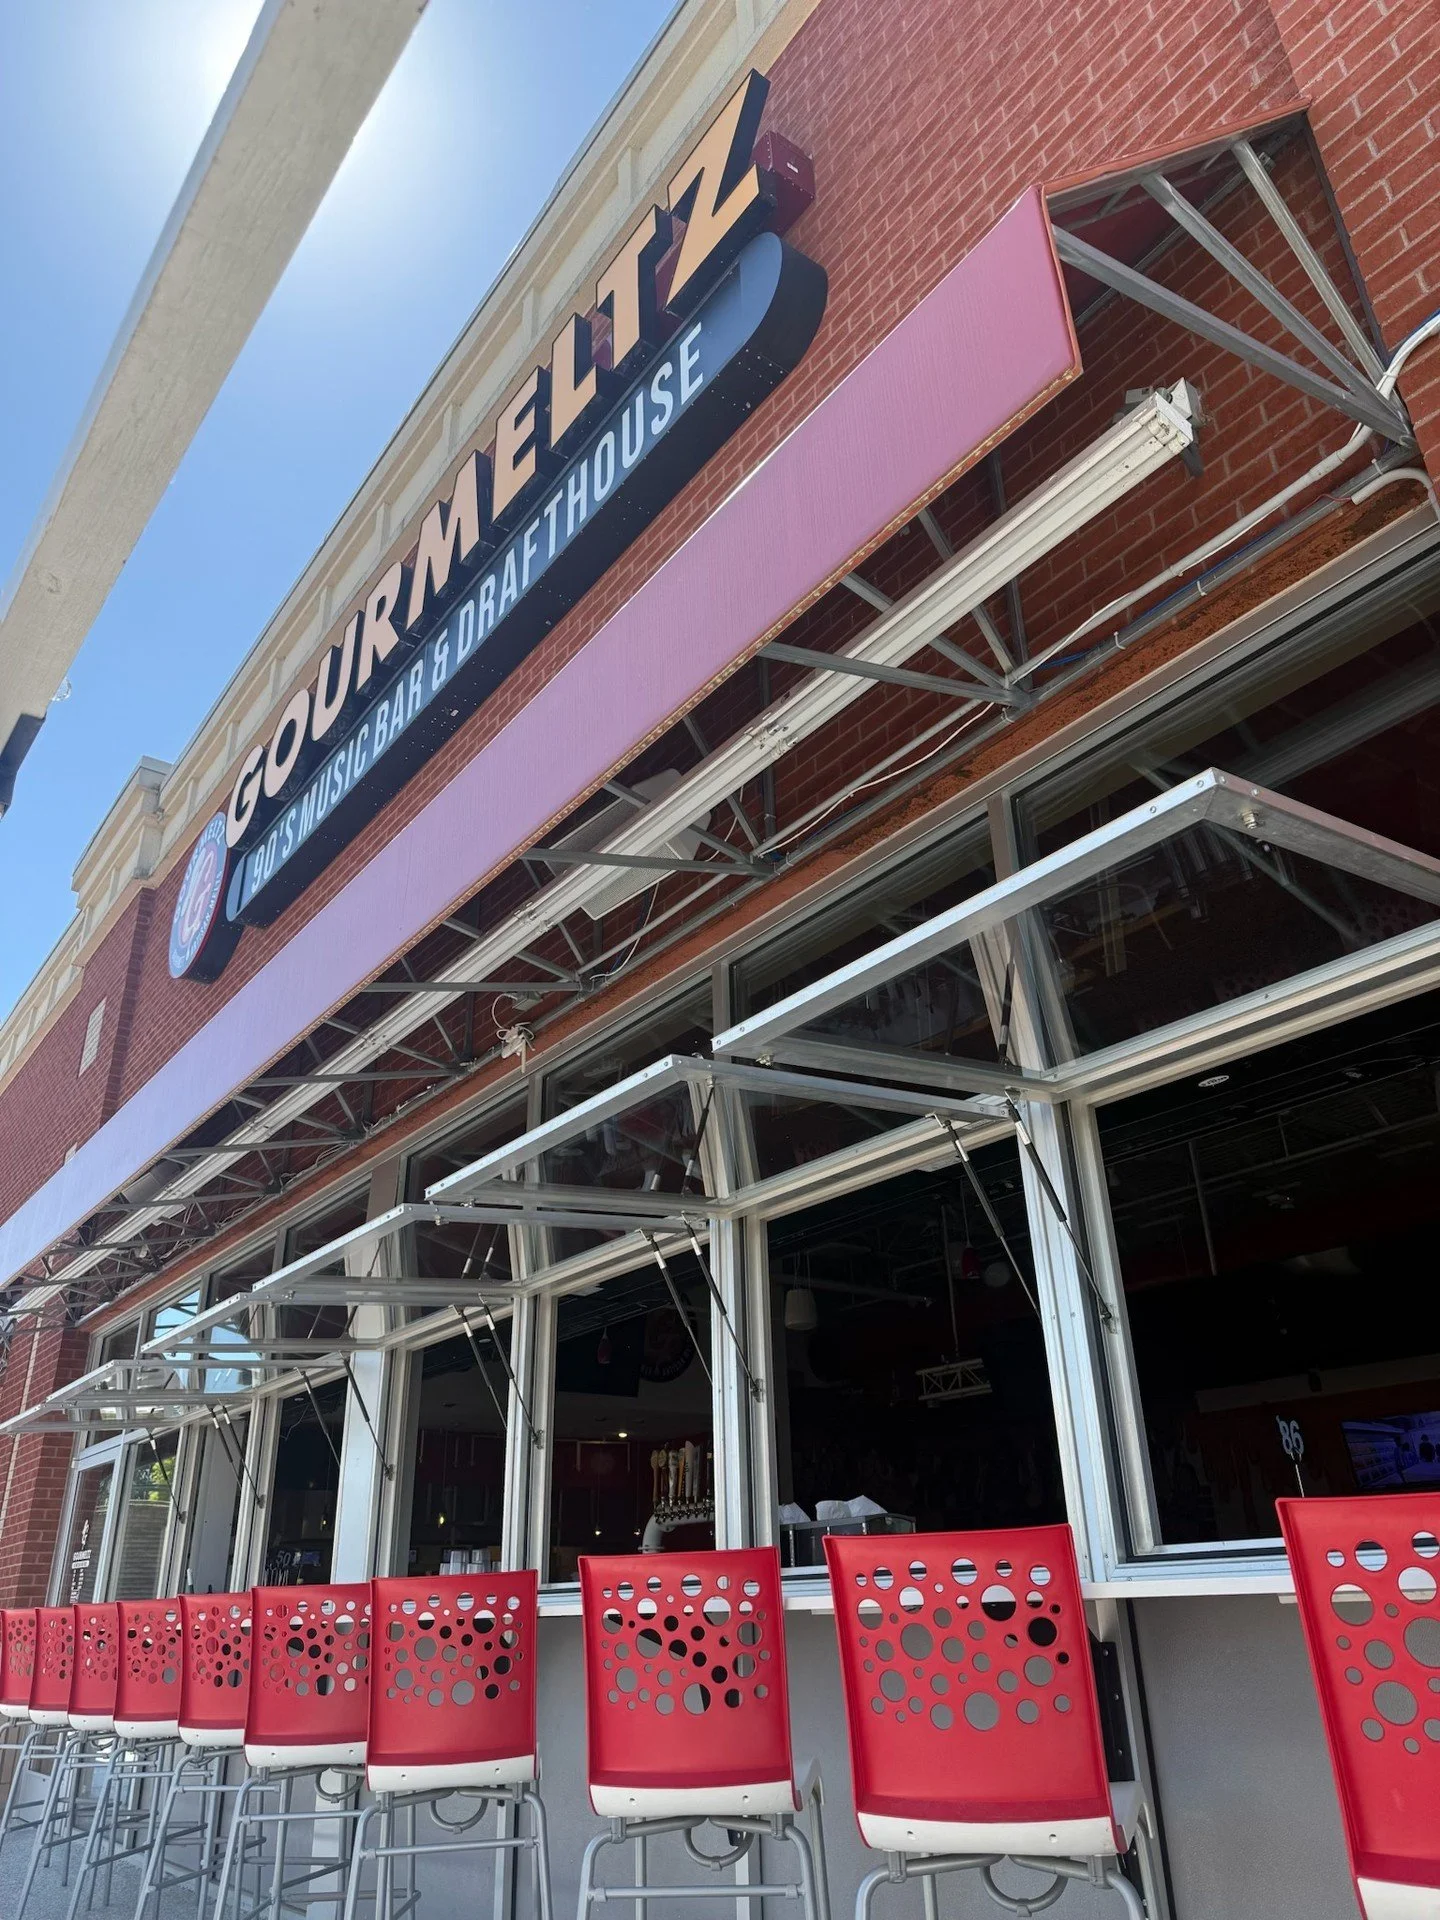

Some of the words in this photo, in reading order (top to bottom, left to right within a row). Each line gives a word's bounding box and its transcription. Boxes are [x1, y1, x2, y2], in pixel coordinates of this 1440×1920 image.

[225, 68, 760, 848] GOURMELTZ
[252, 808, 297, 894] 90'S
[298, 723, 369, 842] MUSIC
[373, 658, 425, 759] BAR
[431, 627, 450, 692] &
[456, 321, 704, 665] DRAFTHOUSE
